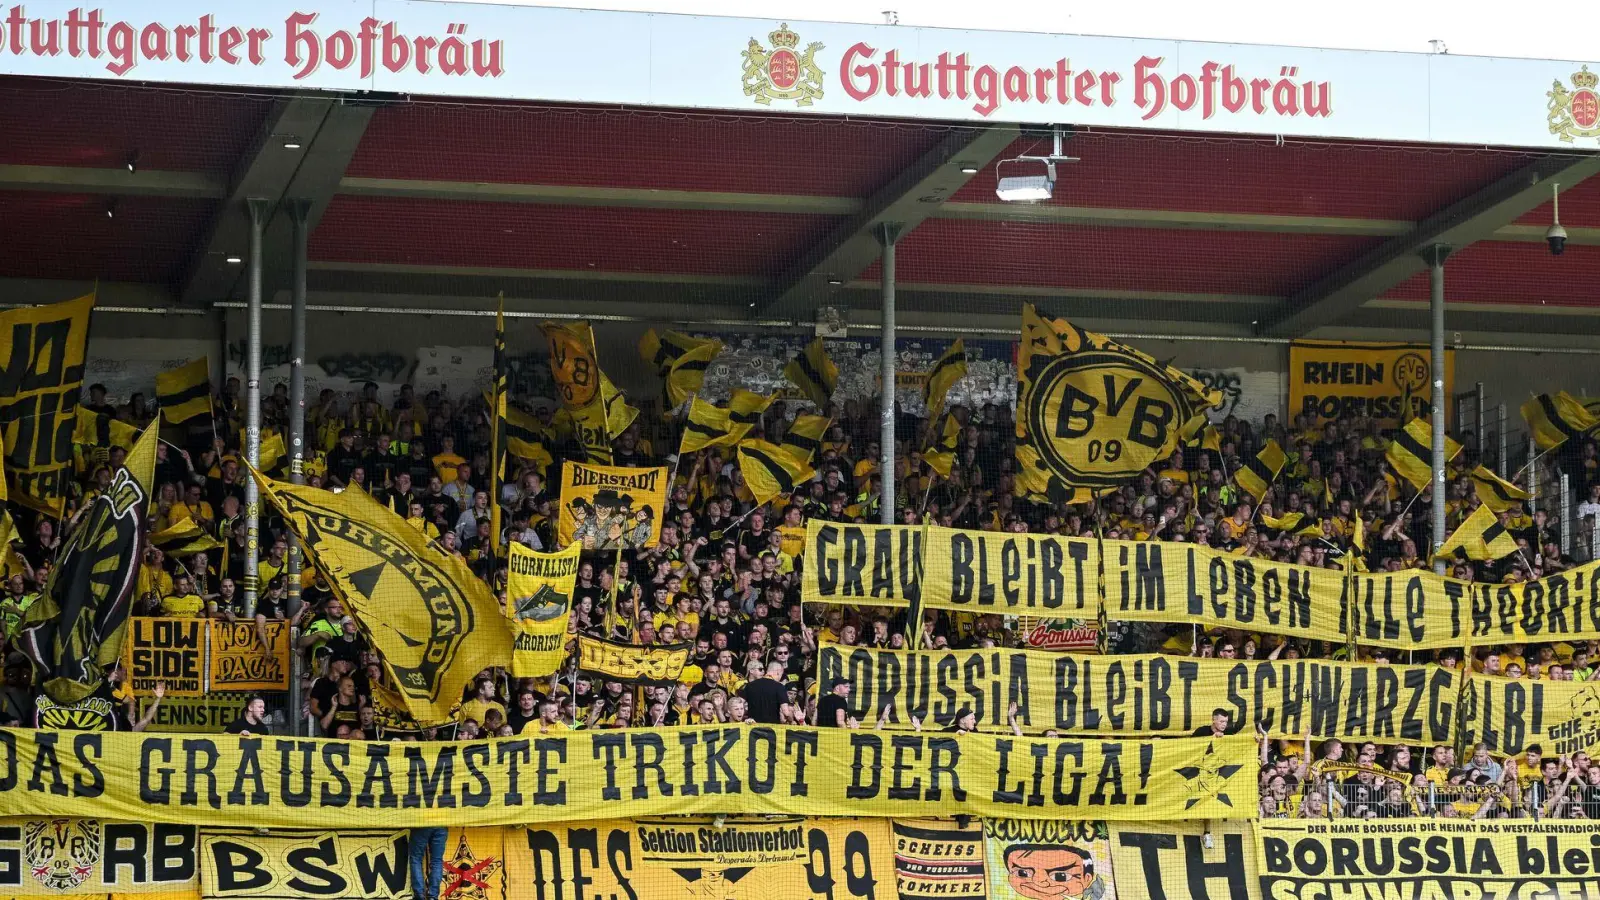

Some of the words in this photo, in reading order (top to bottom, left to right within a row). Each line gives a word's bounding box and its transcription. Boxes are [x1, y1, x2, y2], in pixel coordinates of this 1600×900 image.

[0, 5, 281, 76] tuttgarter
[283, 11, 505, 80] Hofbräu
[838, 41, 1121, 117] Stuttgarter
[1132, 55, 1333, 120] Hofbräu
[1303, 361, 1385, 385] RHEIN
[1056, 375, 1174, 449] BVB
[1088, 440, 1122, 463] 09
[572, 464, 659, 492] BIERSTADT
[511, 553, 577, 578] GIORNALISTA
[816, 524, 922, 602] GRAU
[312, 514, 464, 663] ORTMUND
[134, 620, 198, 648] LOW
[1028, 625, 1098, 647] Borussia
[133, 650, 199, 678] SIDE
[217, 656, 282, 682] PACK
[132, 678, 199, 691] DORMUND
[145, 703, 251, 727] ENNSTEI
[140, 736, 567, 809] GRAUSAMSTE
[592, 727, 819, 801] TRIKOT
[846, 733, 967, 802] DER
[993, 739, 1153, 807] LIGA!
[638, 827, 697, 853] Sektion
[697, 825, 805, 853] Stadionverbot
[1307, 824, 1328, 834] DER
[1330, 824, 1360, 834] NAME
[1362, 824, 1417, 834] BORUSSIA!
[1419, 823, 1437, 833] DIE
[1439, 823, 1477, 834] HEIMAT
[1480, 824, 1500, 834] DAS
[41, 827, 85, 859] BVB
[898, 839, 975, 856] SCHEISS
[1263, 836, 1504, 877] BORUSSIA
[54, 859, 70, 869] 09
[212, 837, 410, 898] BSW
[527, 828, 639, 900] DES
[716, 854, 757, 864] Desperados
[758, 852, 796, 863] Dortmund
[906, 863, 923, 871] PRO
[897, 878, 982, 893] KOMMERZ
